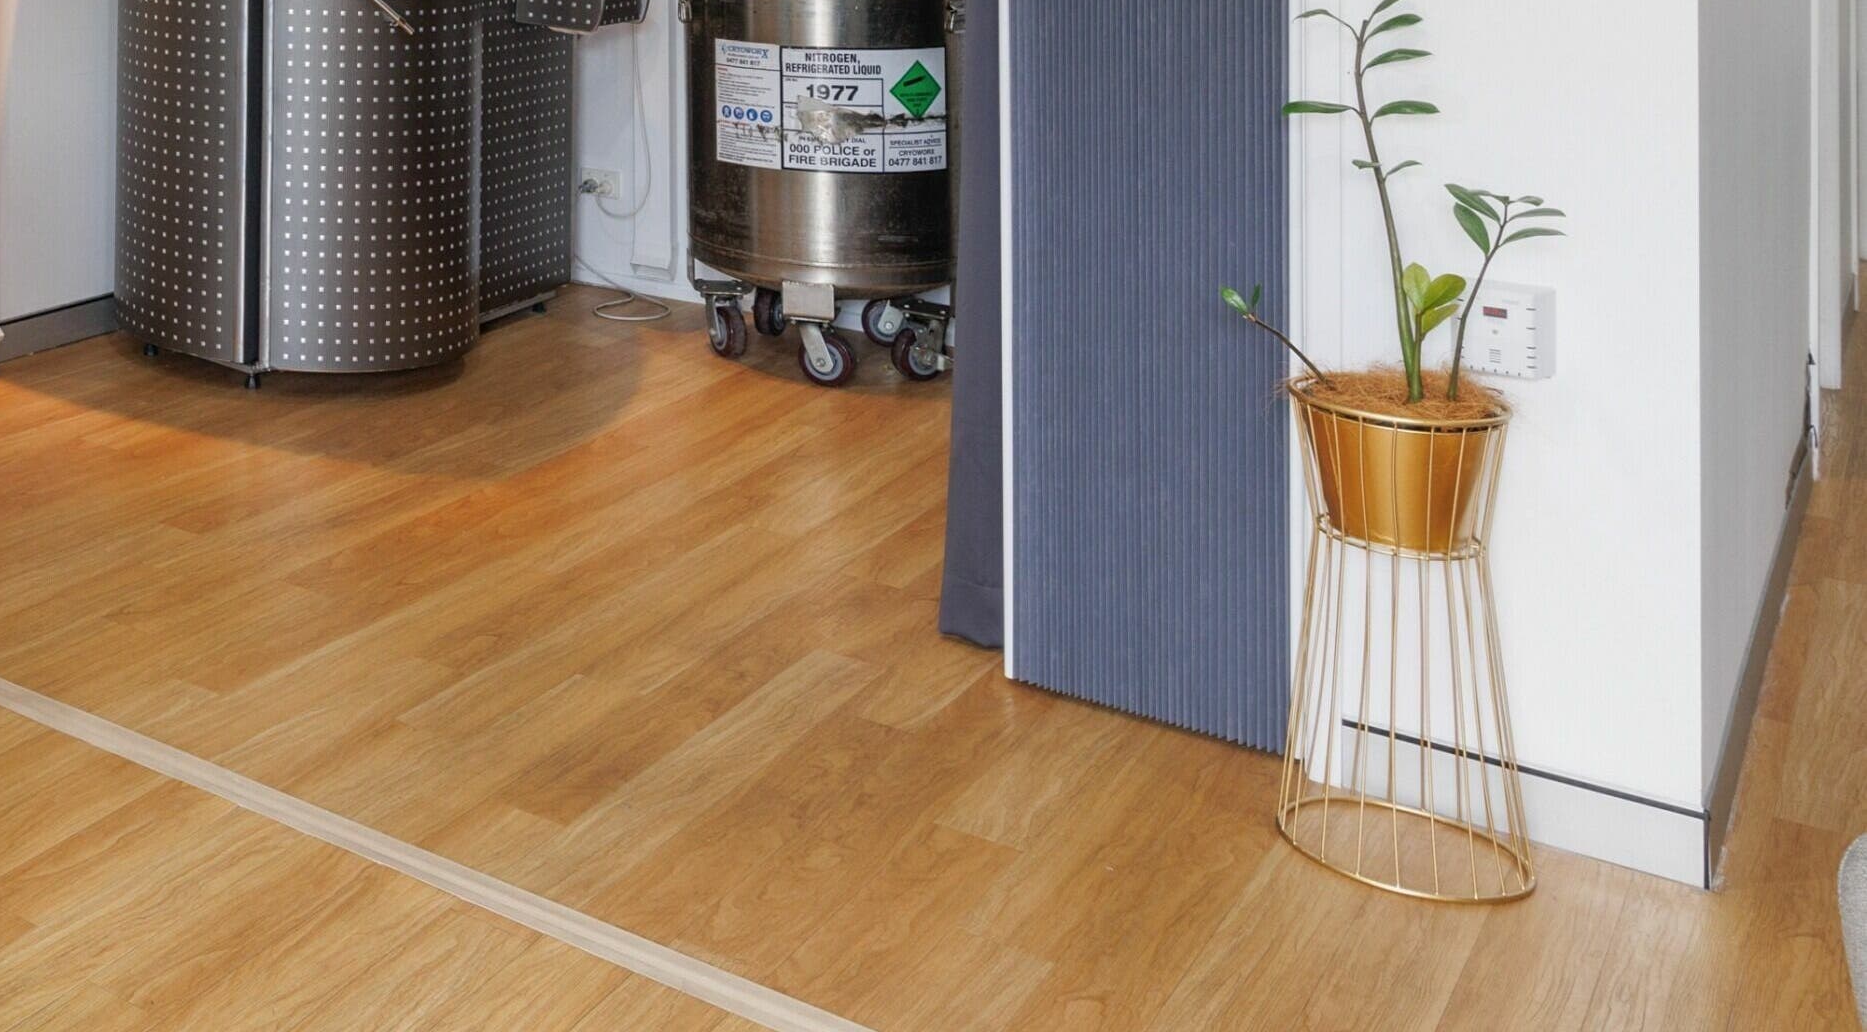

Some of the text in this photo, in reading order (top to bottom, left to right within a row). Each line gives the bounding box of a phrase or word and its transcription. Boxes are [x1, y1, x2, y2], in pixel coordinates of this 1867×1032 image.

[804, 52, 861, 64] NITROGEN,
[785, 62, 882, 75] REFRIGERATED LIQUID
[806, 84, 859, 102] 1977
[789, 143, 876, 156] 000 POLICE or
[789, 154, 877, 167] FIRE BRIGADE
[888, 155, 942, 166] 0477 841 817
